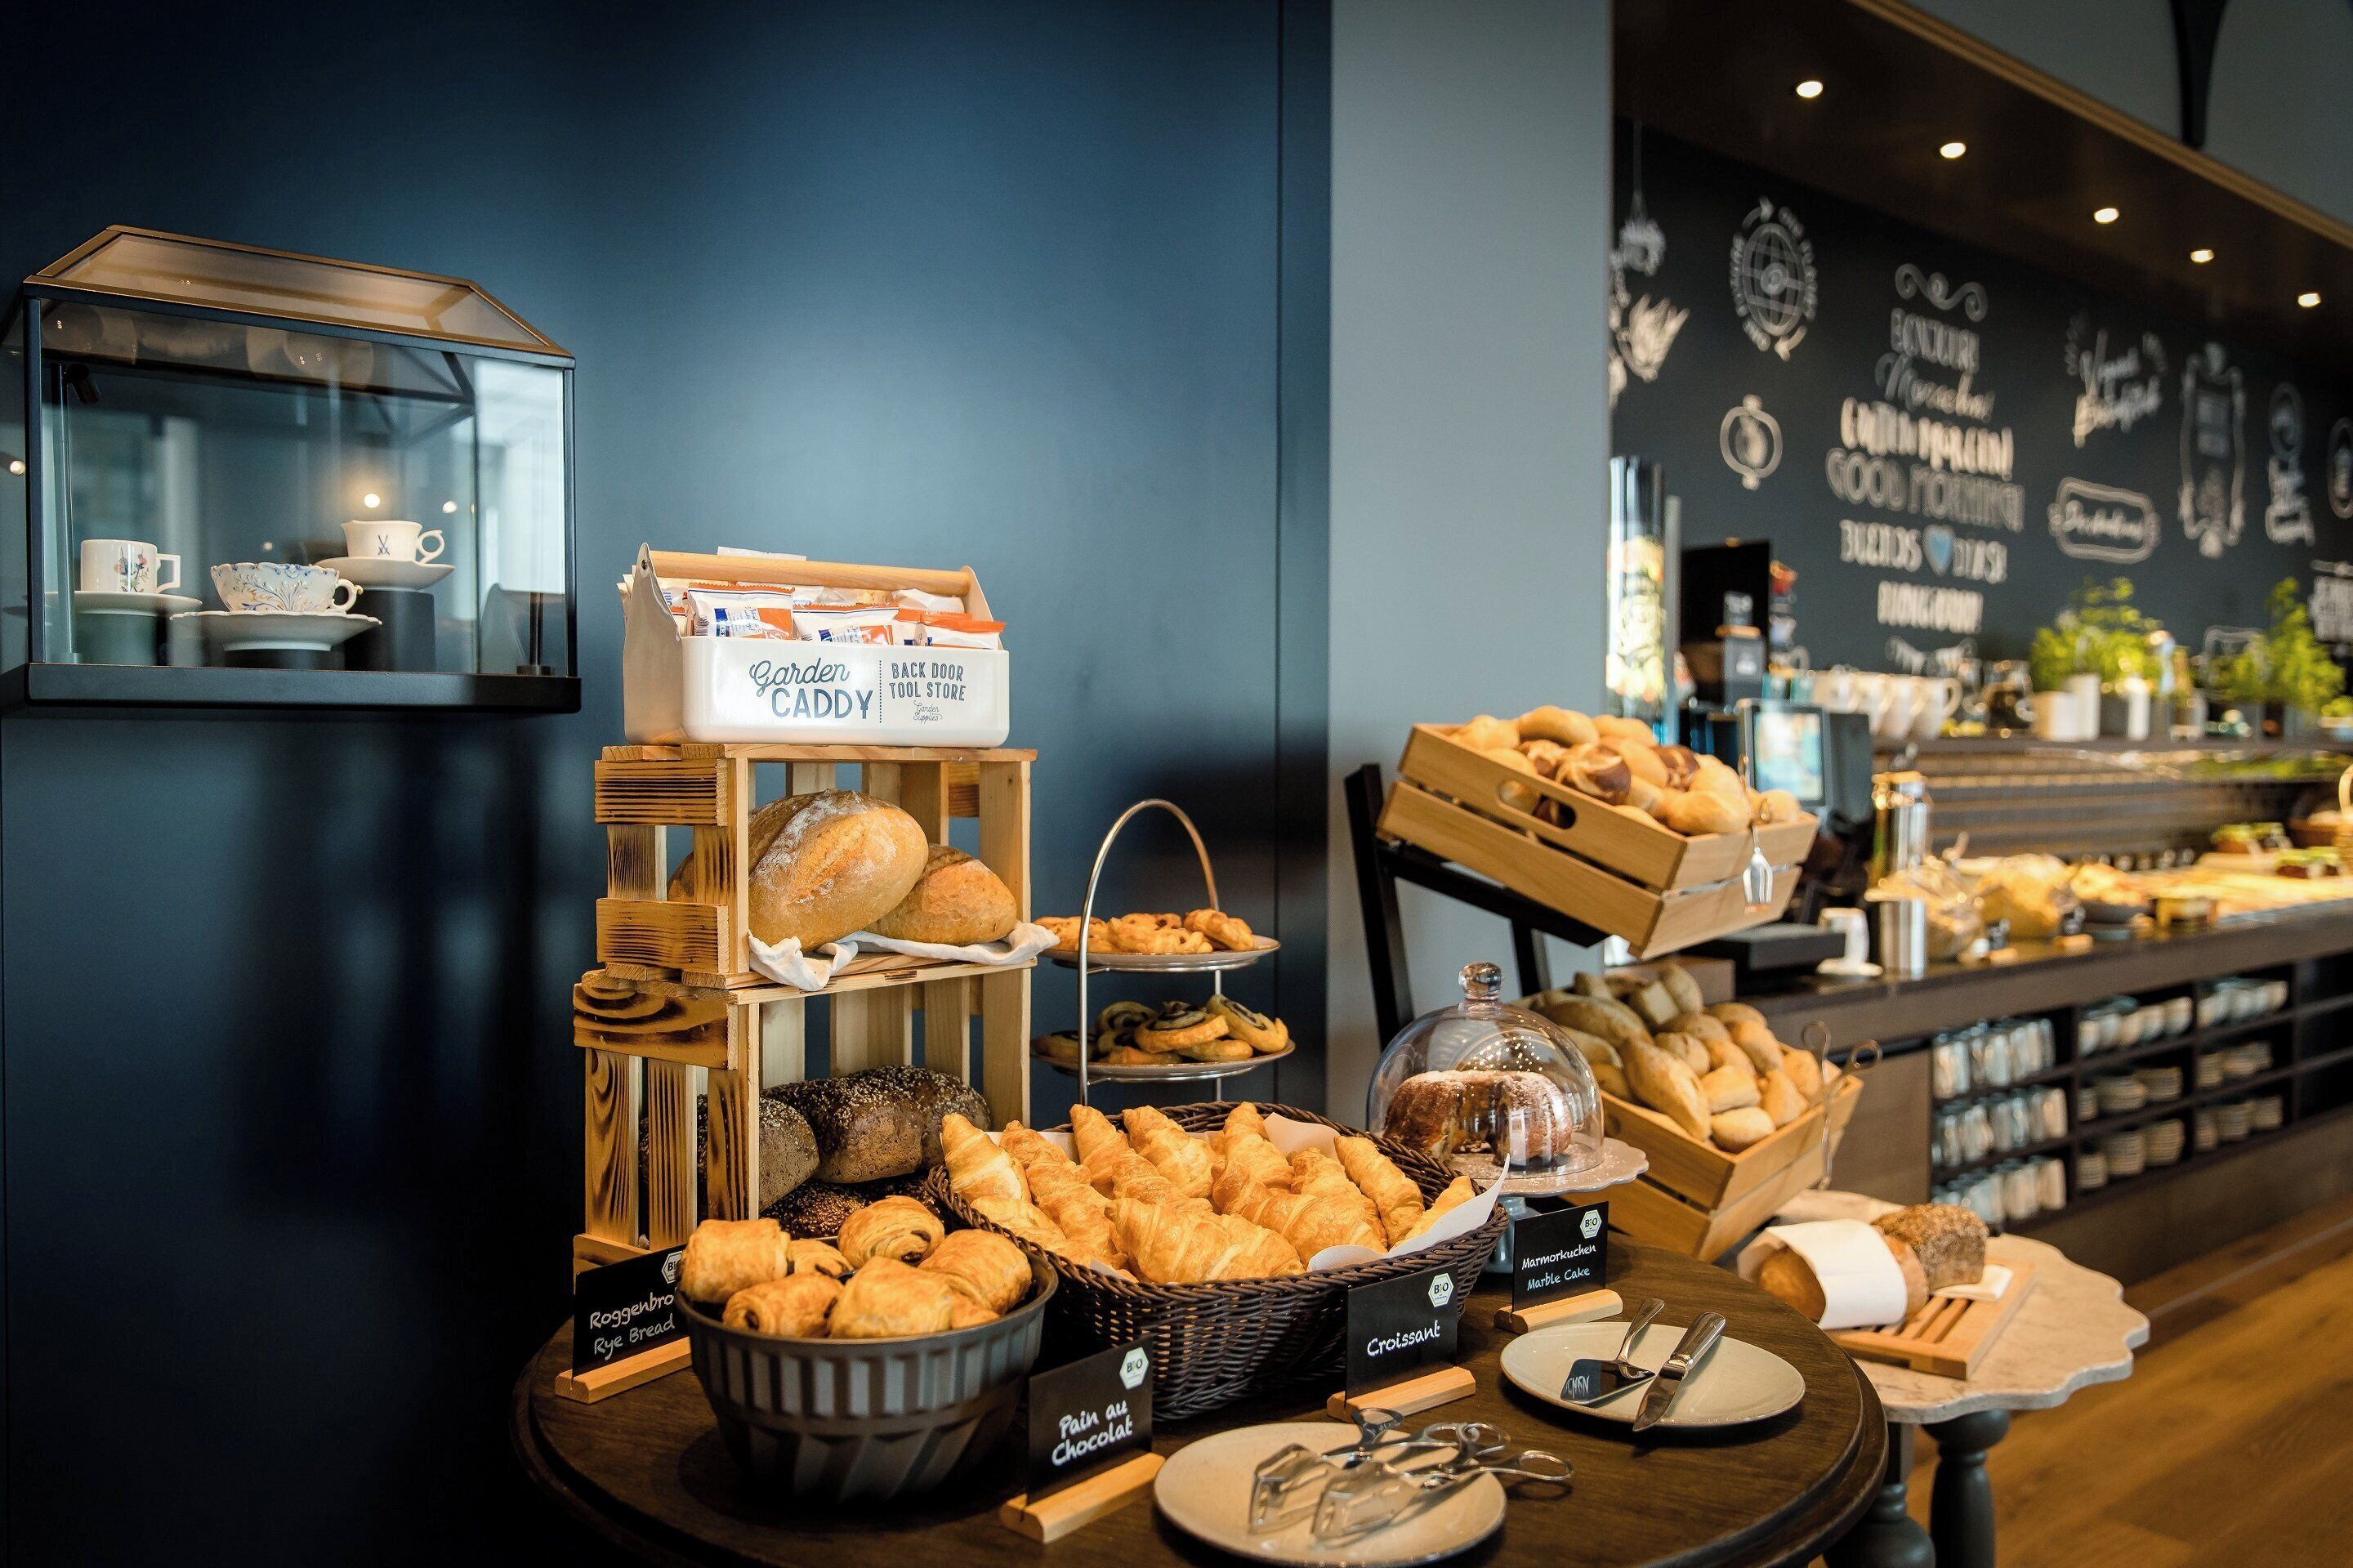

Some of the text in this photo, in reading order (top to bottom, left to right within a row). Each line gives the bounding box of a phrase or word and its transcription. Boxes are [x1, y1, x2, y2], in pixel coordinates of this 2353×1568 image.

[749, 657, 850, 697] Garden
[891, 662, 964, 681] BACK DOOR
[771, 687, 873, 719] CADDY
[889, 681, 966, 701] TOOL STORE
[913, 700, 940, 714] Garden
[913, 711, 943, 724] Supplies
[1521, 1244, 1596, 1270] Marmorkuchen
[1527, 1267, 1591, 1291] Marble Cake
[590, 1289, 676, 1329] Roggenbro
[594, 1312, 675, 1360] Rye Bread
[1367, 1320, 1440, 1356] Croissant
[1059, 1400, 1128, 1439] Pain au
[1051, 1414, 1133, 1467] Chocolat
